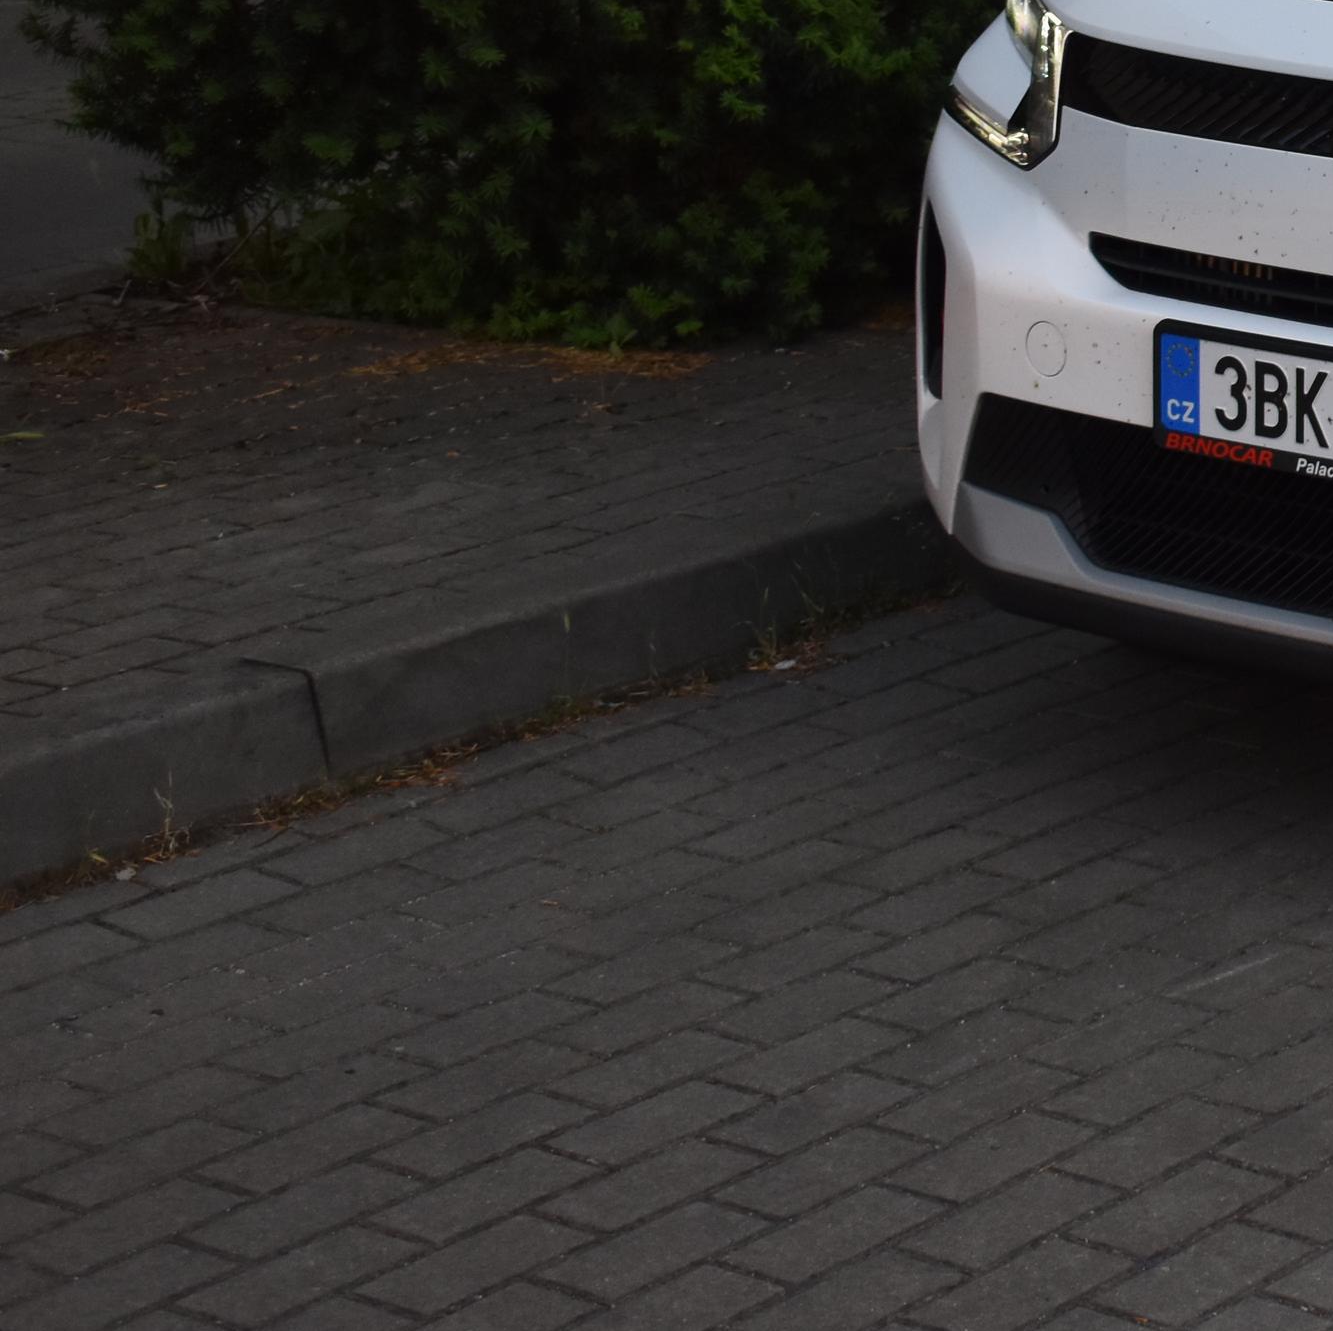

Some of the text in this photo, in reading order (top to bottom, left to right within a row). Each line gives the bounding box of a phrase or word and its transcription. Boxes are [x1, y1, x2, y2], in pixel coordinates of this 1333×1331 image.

[1166, 398, 1196, 424] CZ
[1213, 355, 1330, 449] 3BK
[1165, 433, 1275, 468] BRNOCAR
